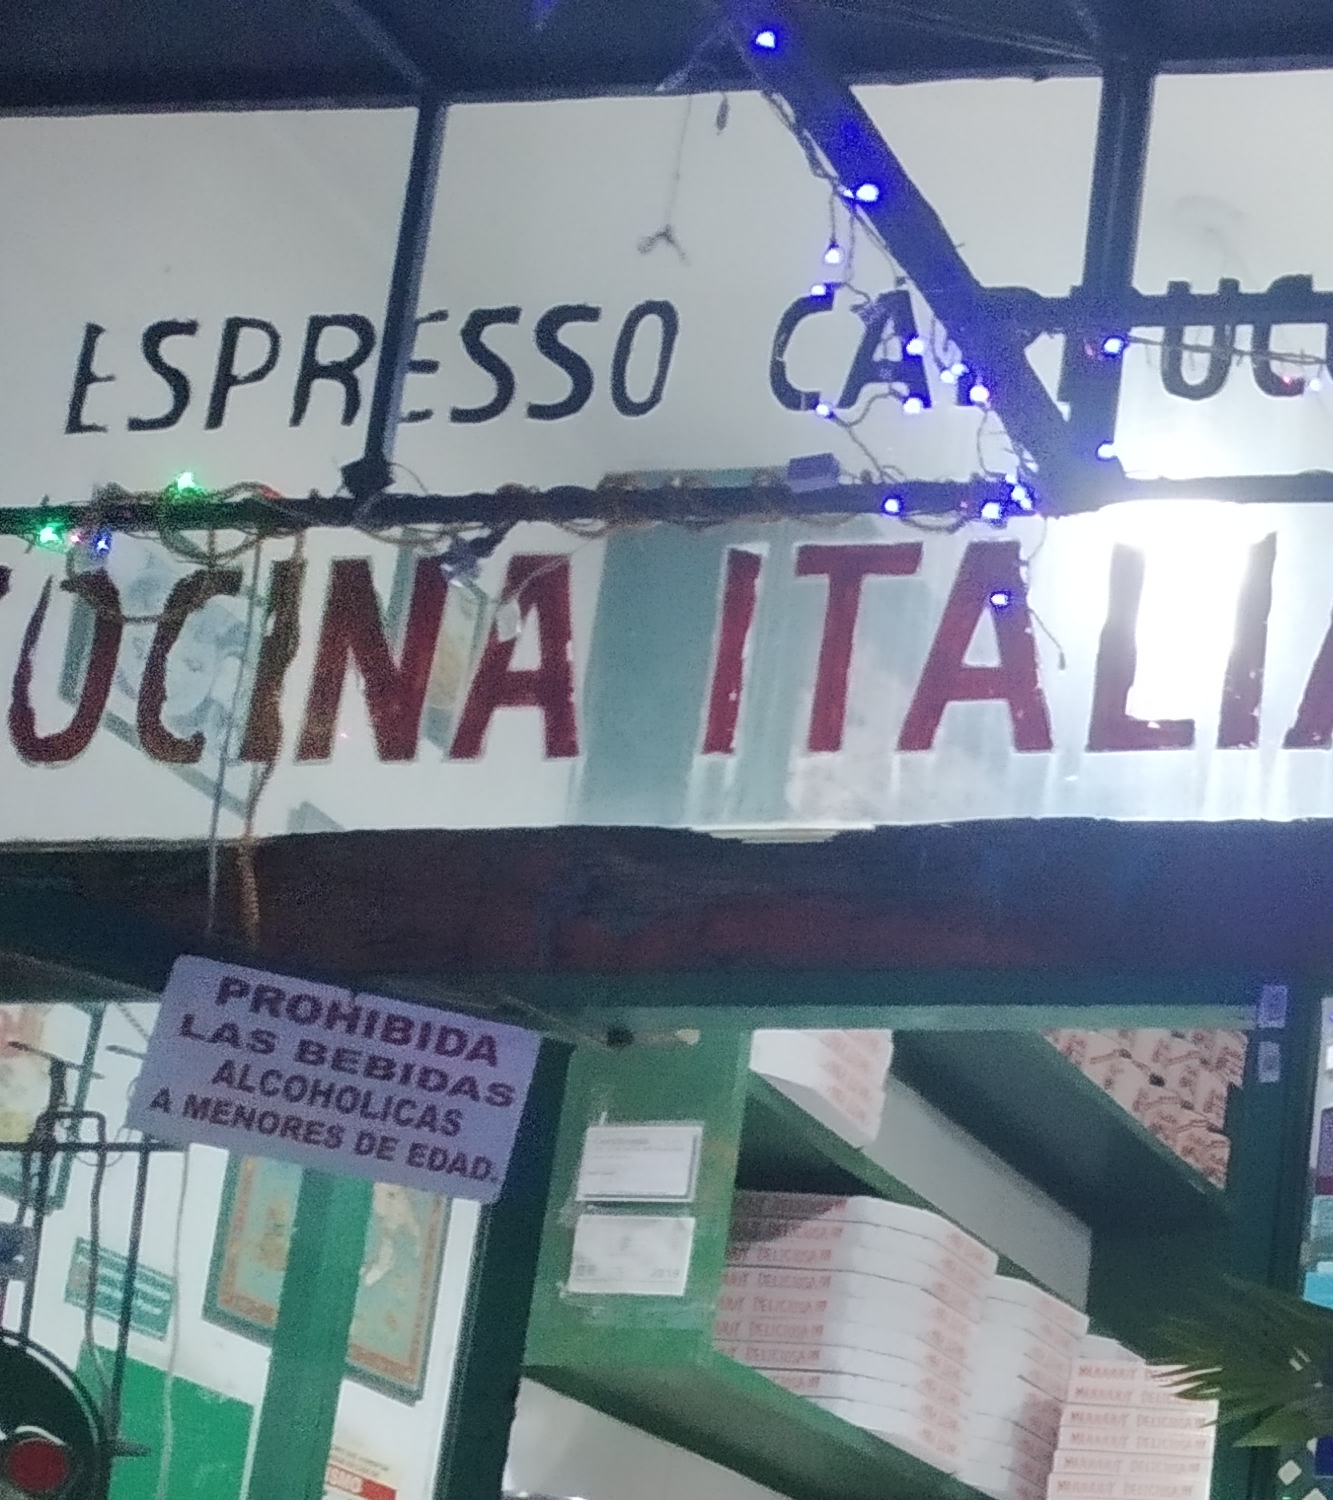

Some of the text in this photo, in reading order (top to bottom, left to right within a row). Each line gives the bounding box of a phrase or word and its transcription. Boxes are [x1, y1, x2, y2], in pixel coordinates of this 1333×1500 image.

[63, 300, 679, 435] ESPRESSO
[0, 552, 580, 764] UCINA
[179, 1013, 517, 1108] LAS BEBIDAS
[214, 976, 499, 1068] PROHIBIDA
[149, 1086, 498, 1183] A MENORES DE EDAD.
[211, 1058, 464, 1138] ALCOHOLICAS
